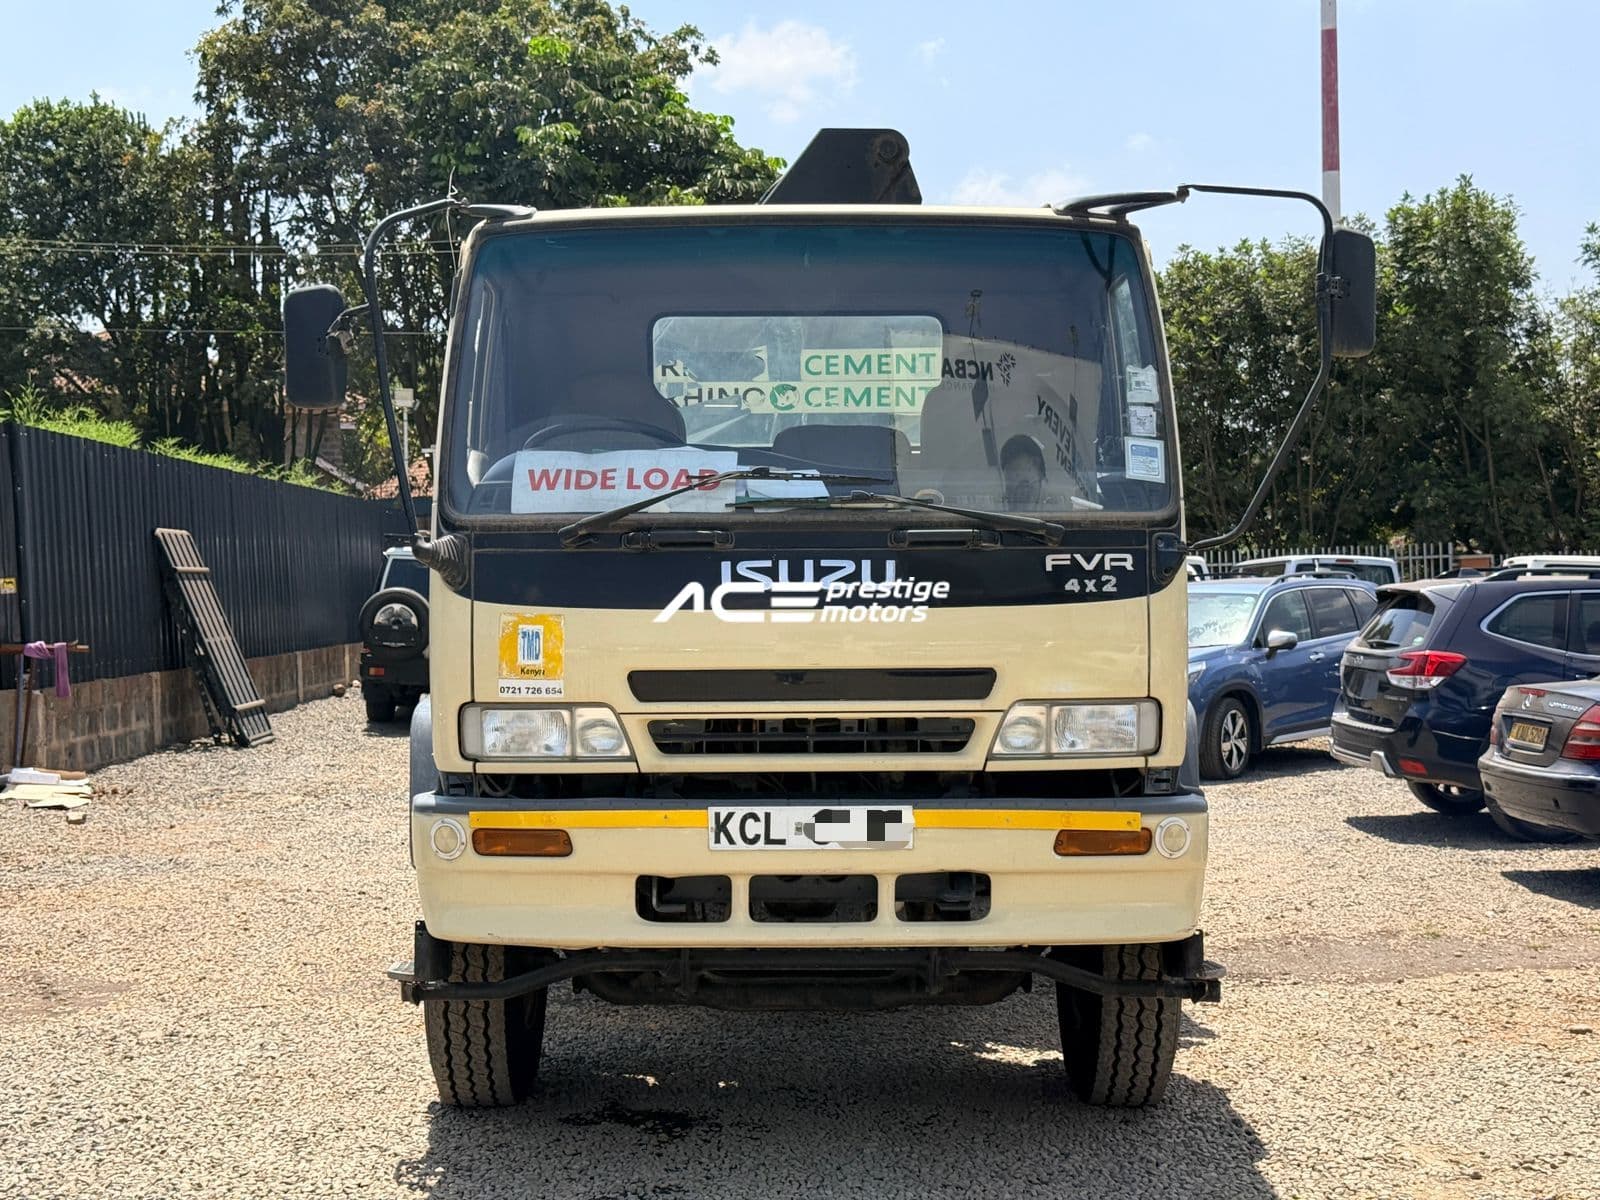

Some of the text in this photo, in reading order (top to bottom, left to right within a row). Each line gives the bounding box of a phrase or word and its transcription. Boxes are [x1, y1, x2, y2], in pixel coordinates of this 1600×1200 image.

[804, 353, 937, 376] CEMENT
[664, 387, 766, 408] HINO
[528, 468, 721, 491] WIDE LOAD
[1045, 553, 1134, 571] FVR
[720, 559, 896, 590] ISUZU
[500, 686, 562, 695] 0721 726 654
[714, 811, 786, 845] KCL
